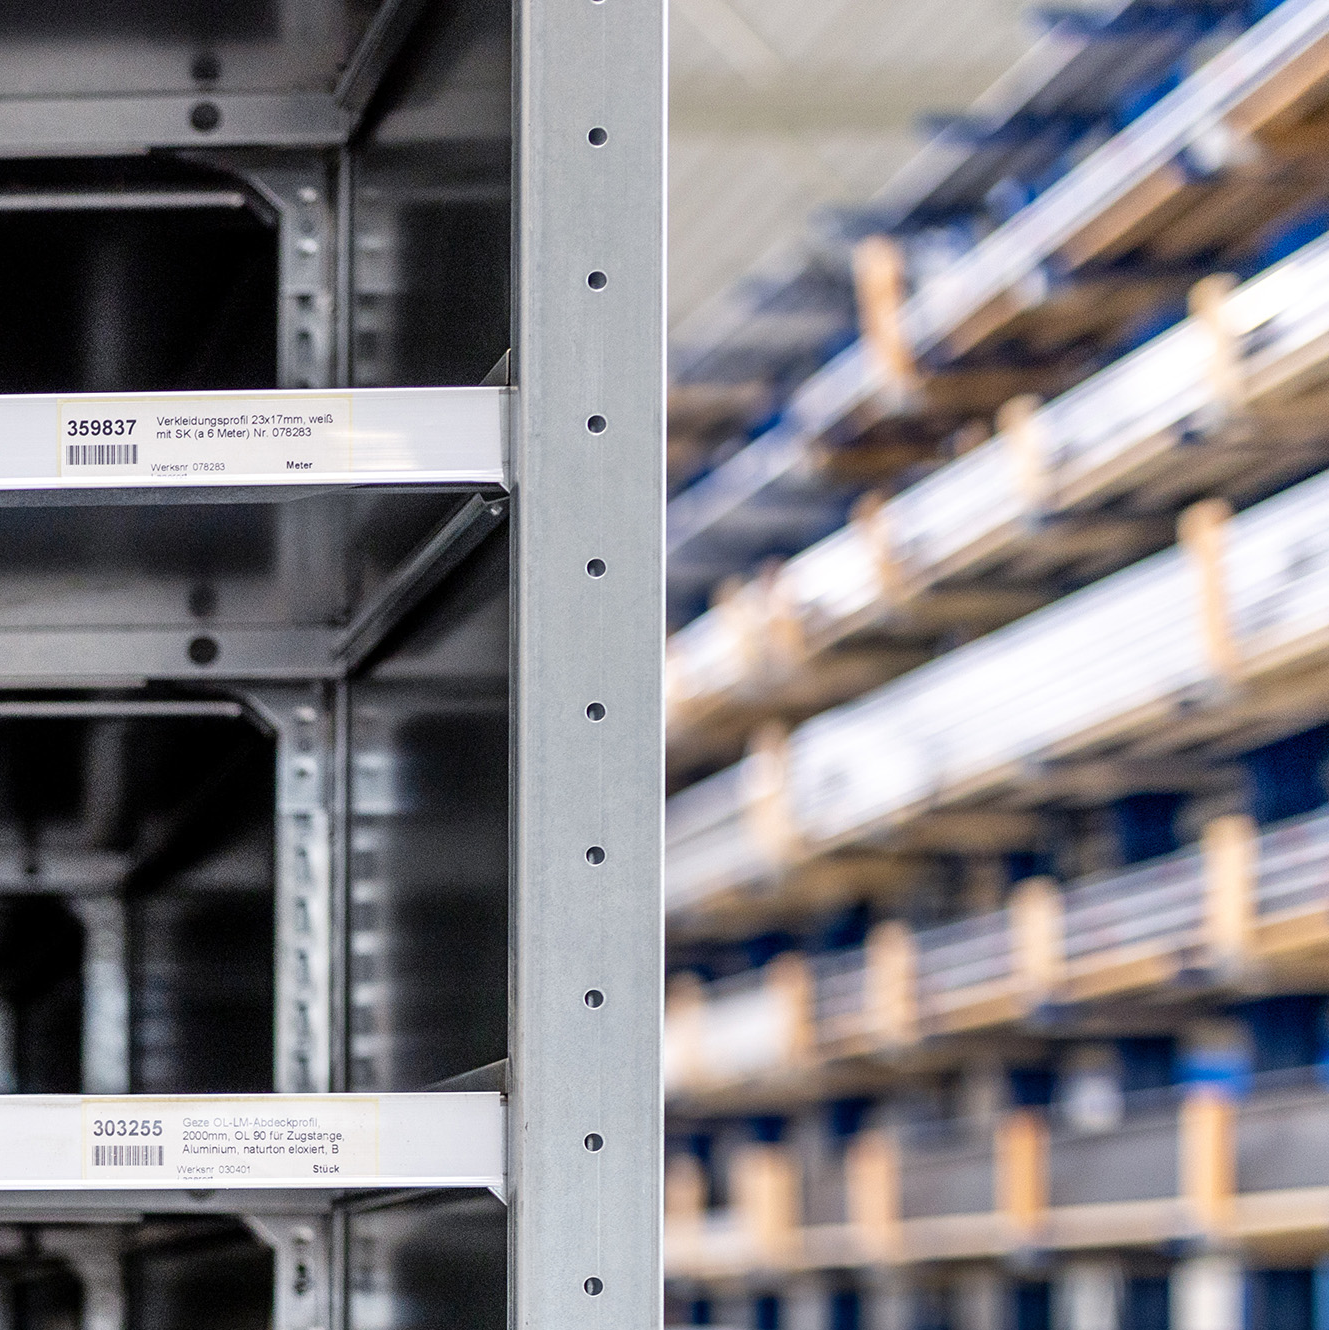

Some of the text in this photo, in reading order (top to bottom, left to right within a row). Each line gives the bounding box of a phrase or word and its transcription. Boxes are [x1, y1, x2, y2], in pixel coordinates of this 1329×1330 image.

[157, 414, 333, 427] Verkleidungsprofil 23x17mm, weiß
[67, 420, 137, 436] 359837
[157, 427, 311, 440] mit SK (a 6 Meter) Nr. 078283
[151, 461, 313, 472] Werksnr 078283 Meter
[93, 1120, 163, 1136] 303255
[183, 1117, 321, 1129] Geze OL-LM-Abdeckprofil,
[183, 1131, 231, 1142] 2000mm,
[234, 1131, 249, 1140] OL
[253, 1131, 266, 1140] 90
[269, 1131, 283, 1141] für
[183, 1144, 339, 1155] Aluminium, naturton eloxiert, B
[177, 1164, 339, 1174] Werksnr 030401 Stück
